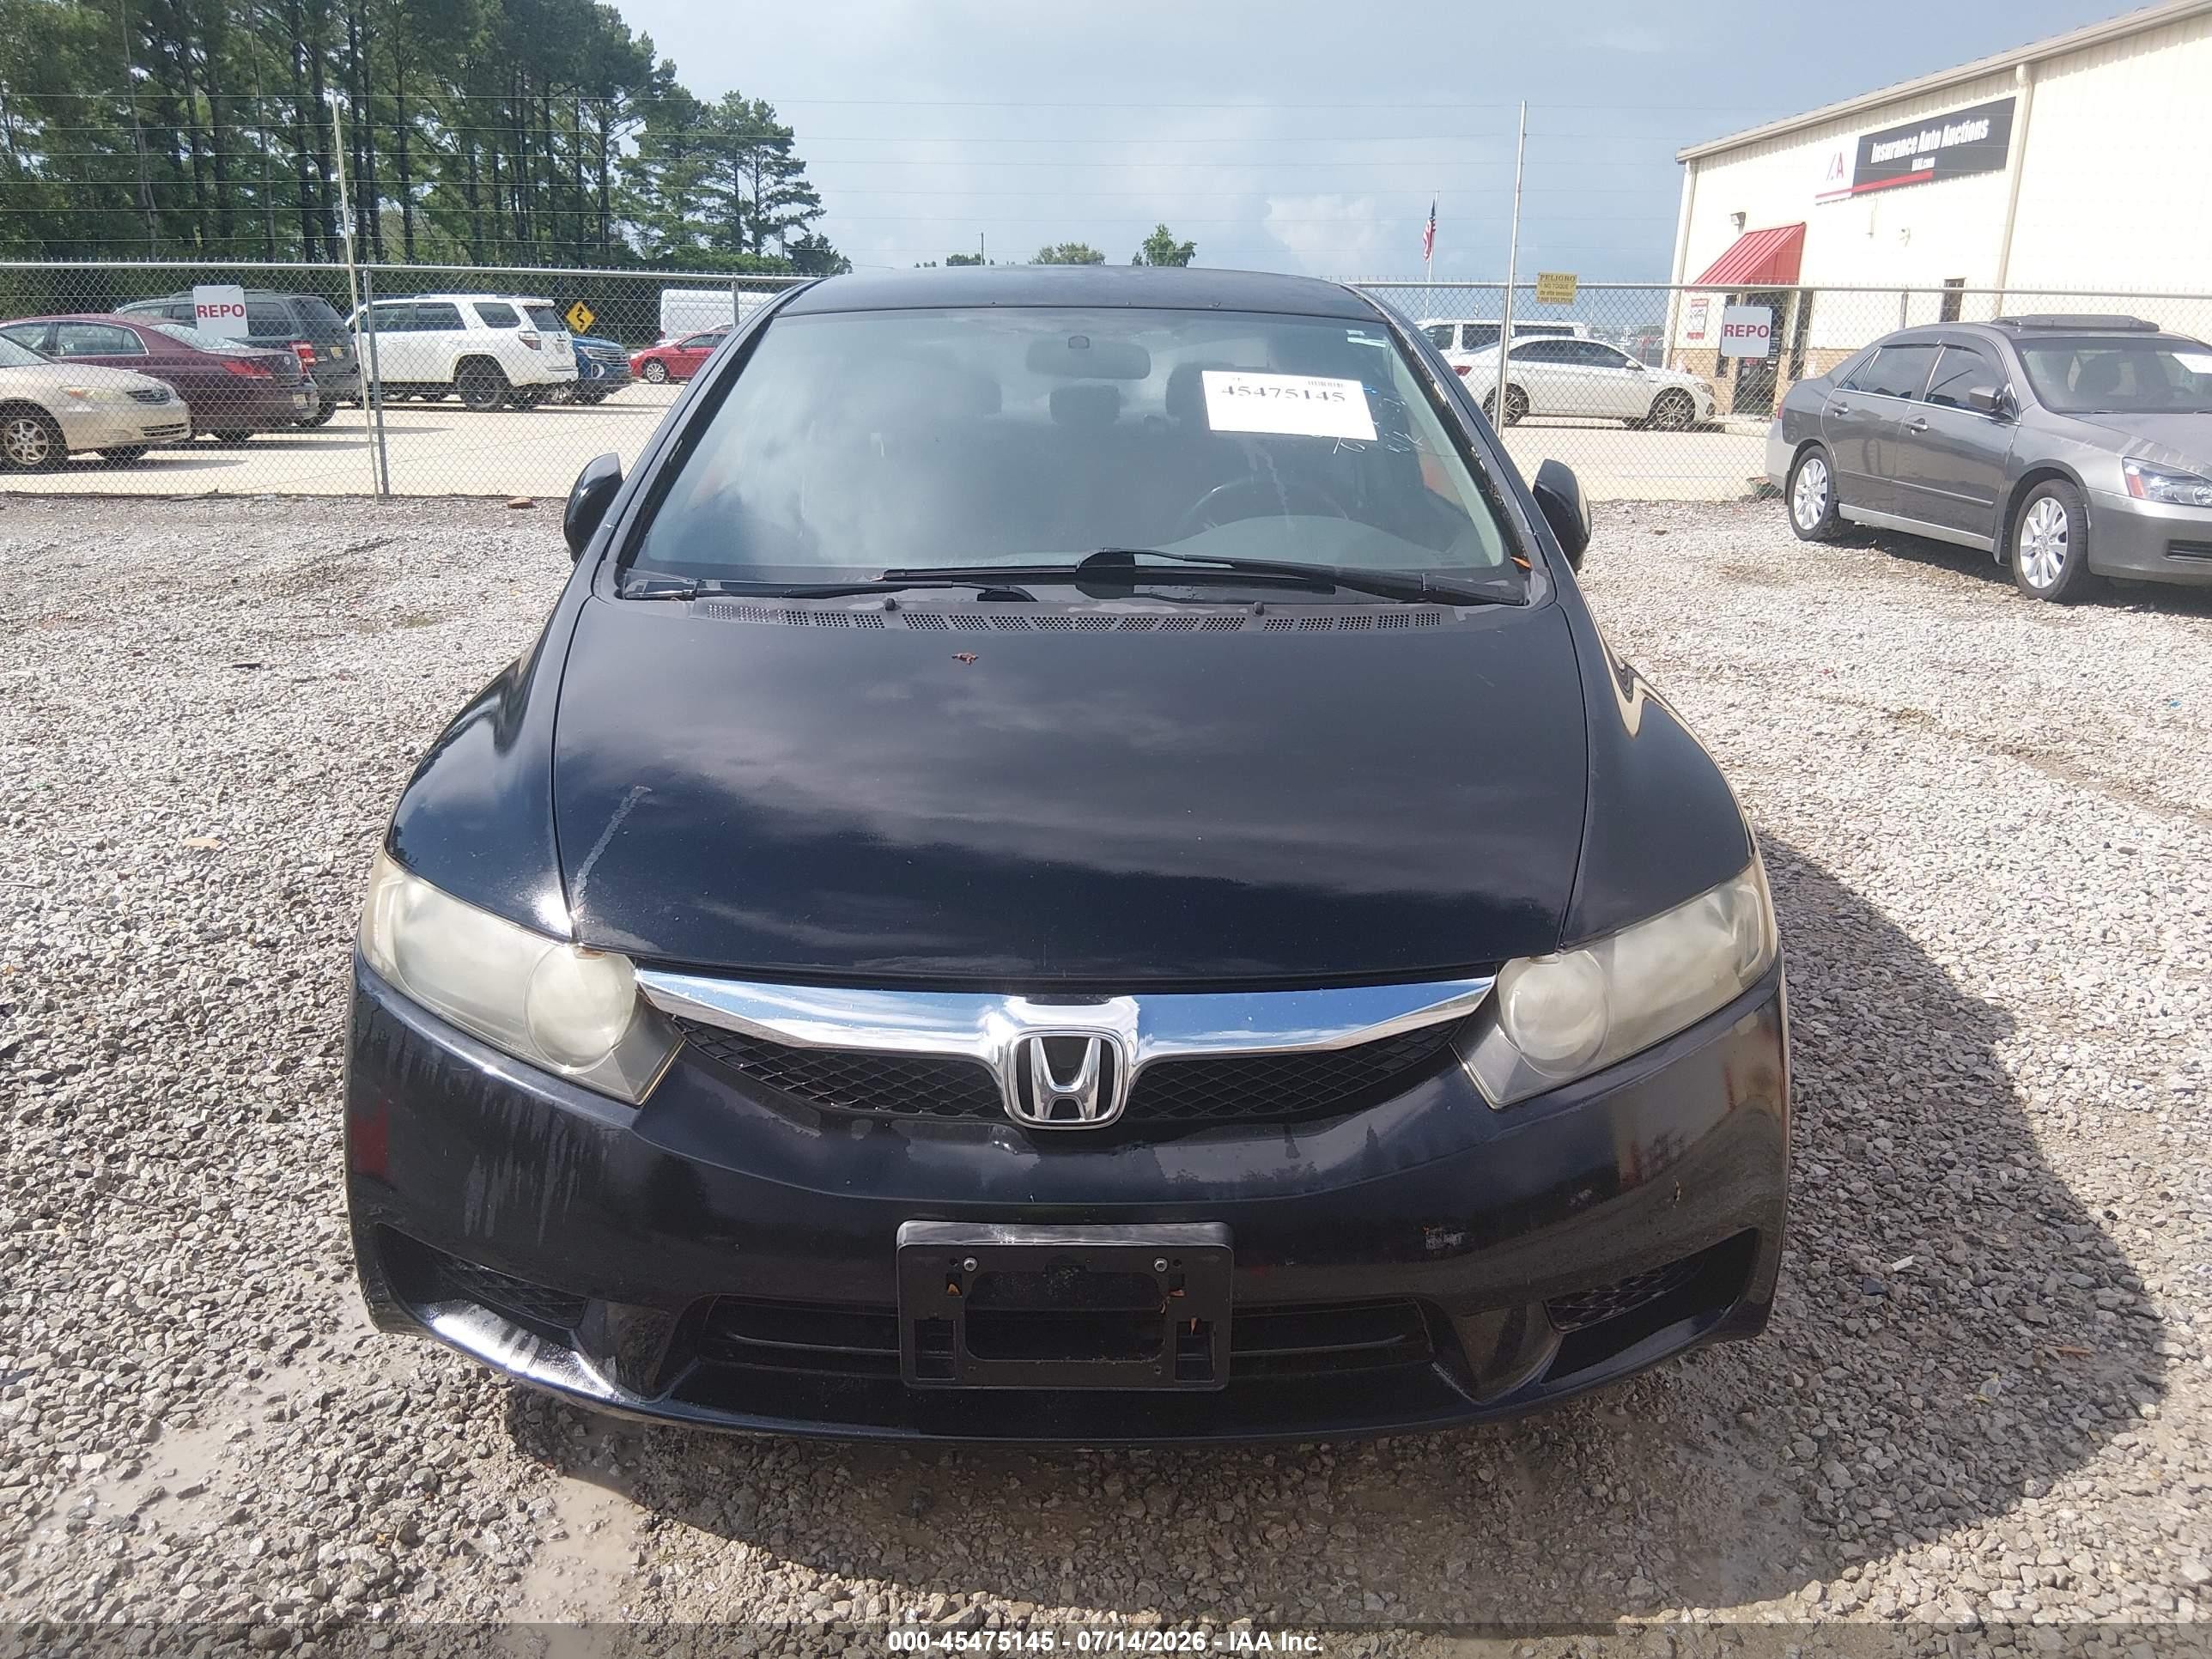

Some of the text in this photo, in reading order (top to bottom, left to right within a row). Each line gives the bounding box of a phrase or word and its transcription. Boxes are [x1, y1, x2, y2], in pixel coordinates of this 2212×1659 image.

[1870, 119, 1990, 164] Insurance Auto Auctions
[196, 304, 245, 318] REPO
[1723, 324, 1770, 338] REPO
[1222, 386, 1346, 402] 45475145
